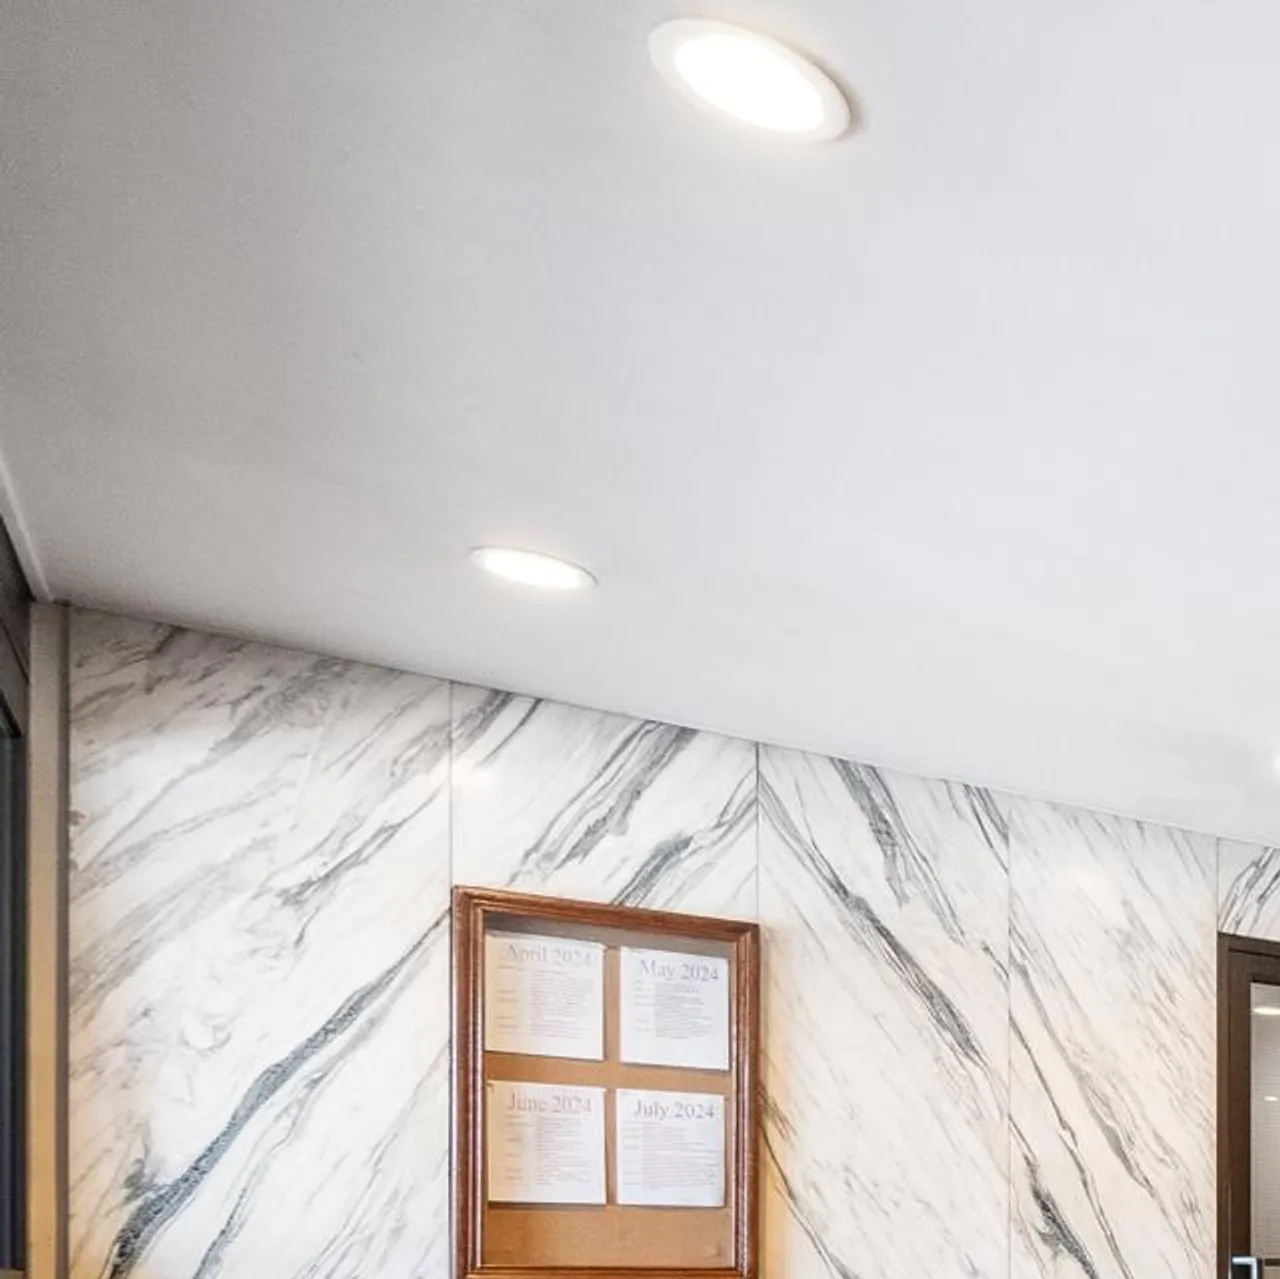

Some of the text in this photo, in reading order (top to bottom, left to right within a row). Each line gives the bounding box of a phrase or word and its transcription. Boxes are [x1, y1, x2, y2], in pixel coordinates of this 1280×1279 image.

[506, 943, 548, 966] April
[640, 959, 719, 981] May 2024
[508, 1092, 592, 1114] June 2024
[634, 1099, 715, 1121] July 2024
